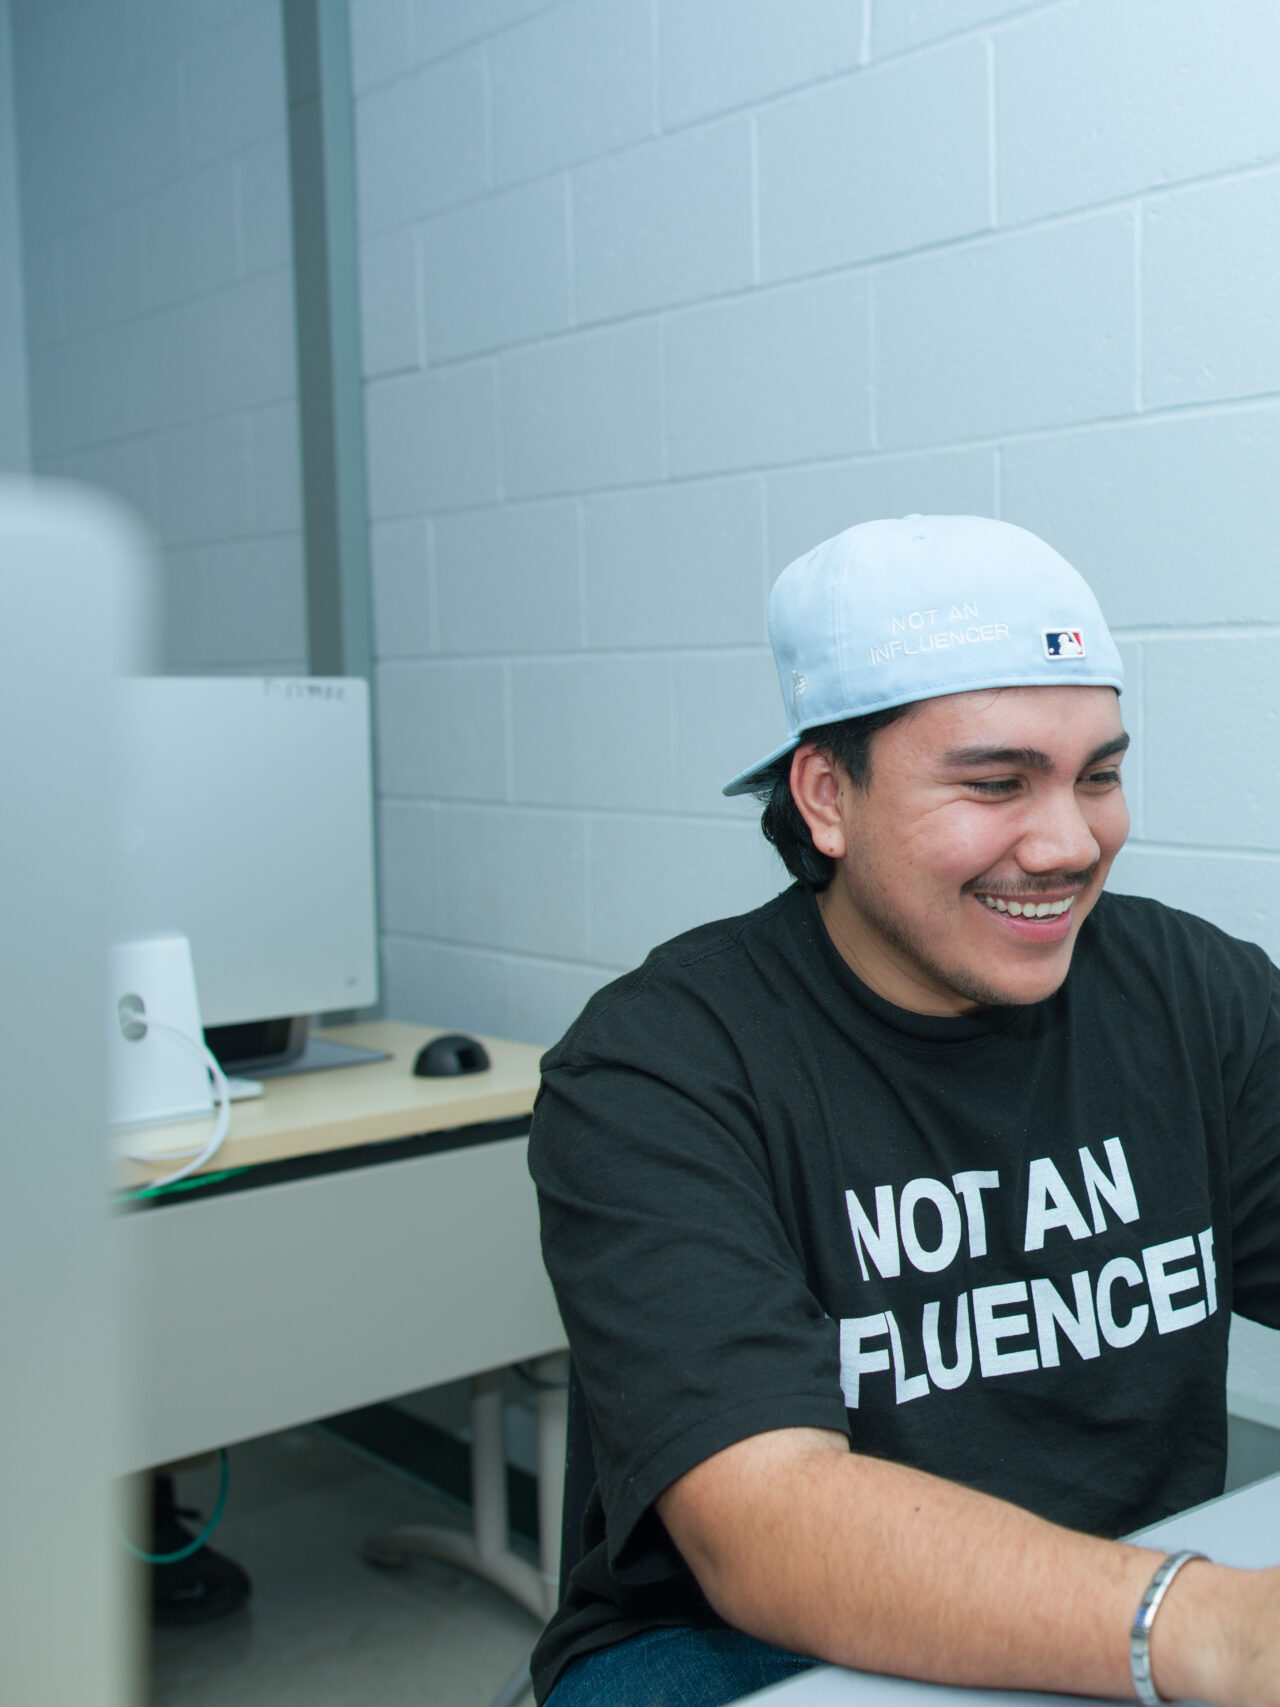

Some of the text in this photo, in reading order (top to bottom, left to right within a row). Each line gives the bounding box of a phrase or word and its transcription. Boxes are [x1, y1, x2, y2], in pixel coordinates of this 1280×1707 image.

[890, 601, 980, 635] NOT AN
[868, 623, 1011, 665] INFLUENCER
[844, 1136, 1141, 1282] NOT AN
